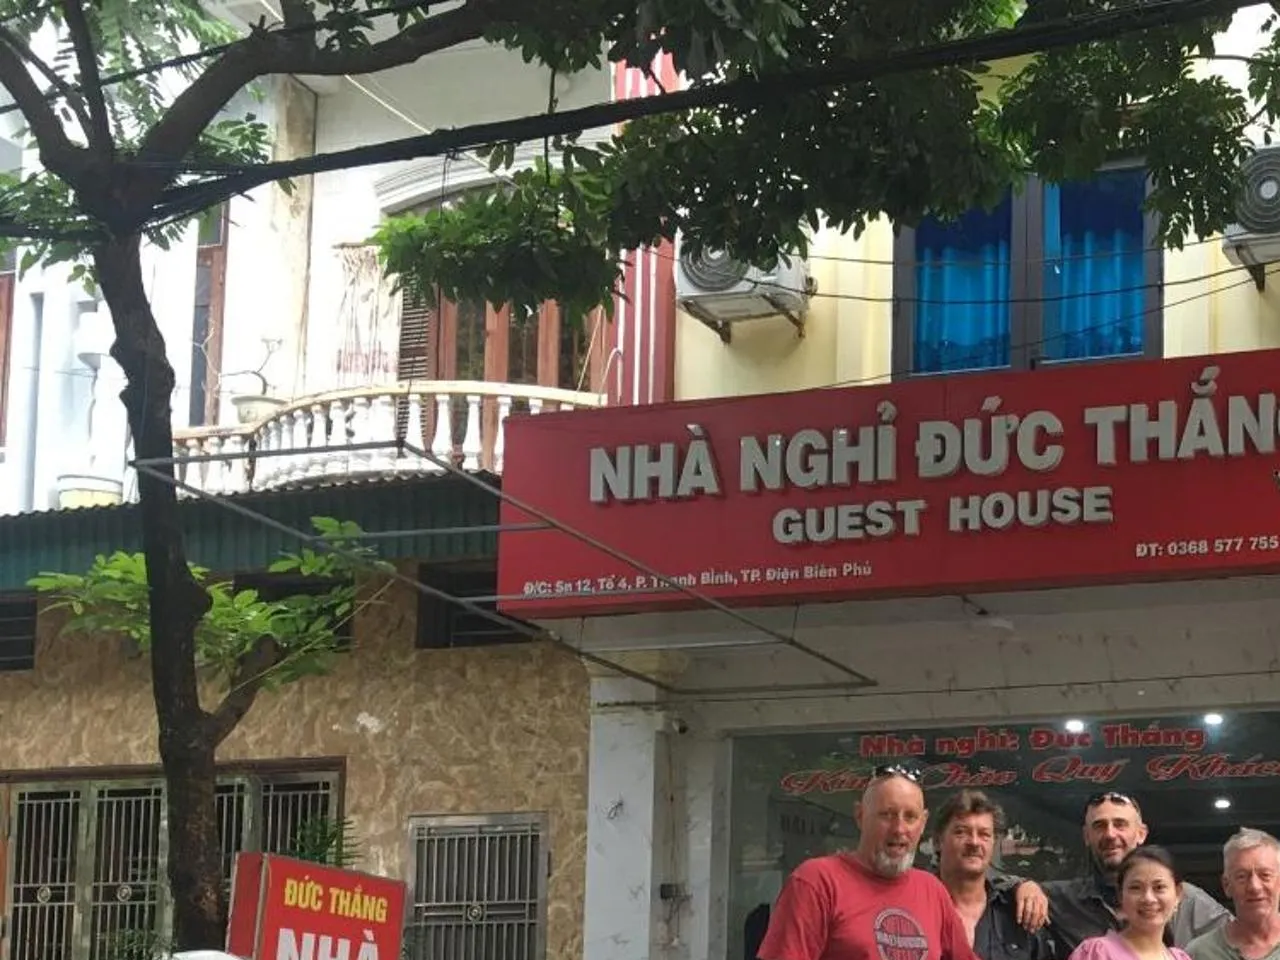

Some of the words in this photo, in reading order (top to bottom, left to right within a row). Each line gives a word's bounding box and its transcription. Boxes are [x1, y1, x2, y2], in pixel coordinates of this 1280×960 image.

[589, 424, 721, 503] NHÀ
[740, 400, 898, 491] NGHỈ
[916, 396, 1064, 480] ĐỨC
[772, 500, 926, 544] GUEST
[949, 485, 1113, 532] HOUSE
[1167, 541, 1209, 556] 0368
[1213, 537, 1244, 553] 577
[1249, 534, 1279, 551] 755
[284, 874, 324, 913] ĐỨC
[329, 884, 389, 923] THẮNG
